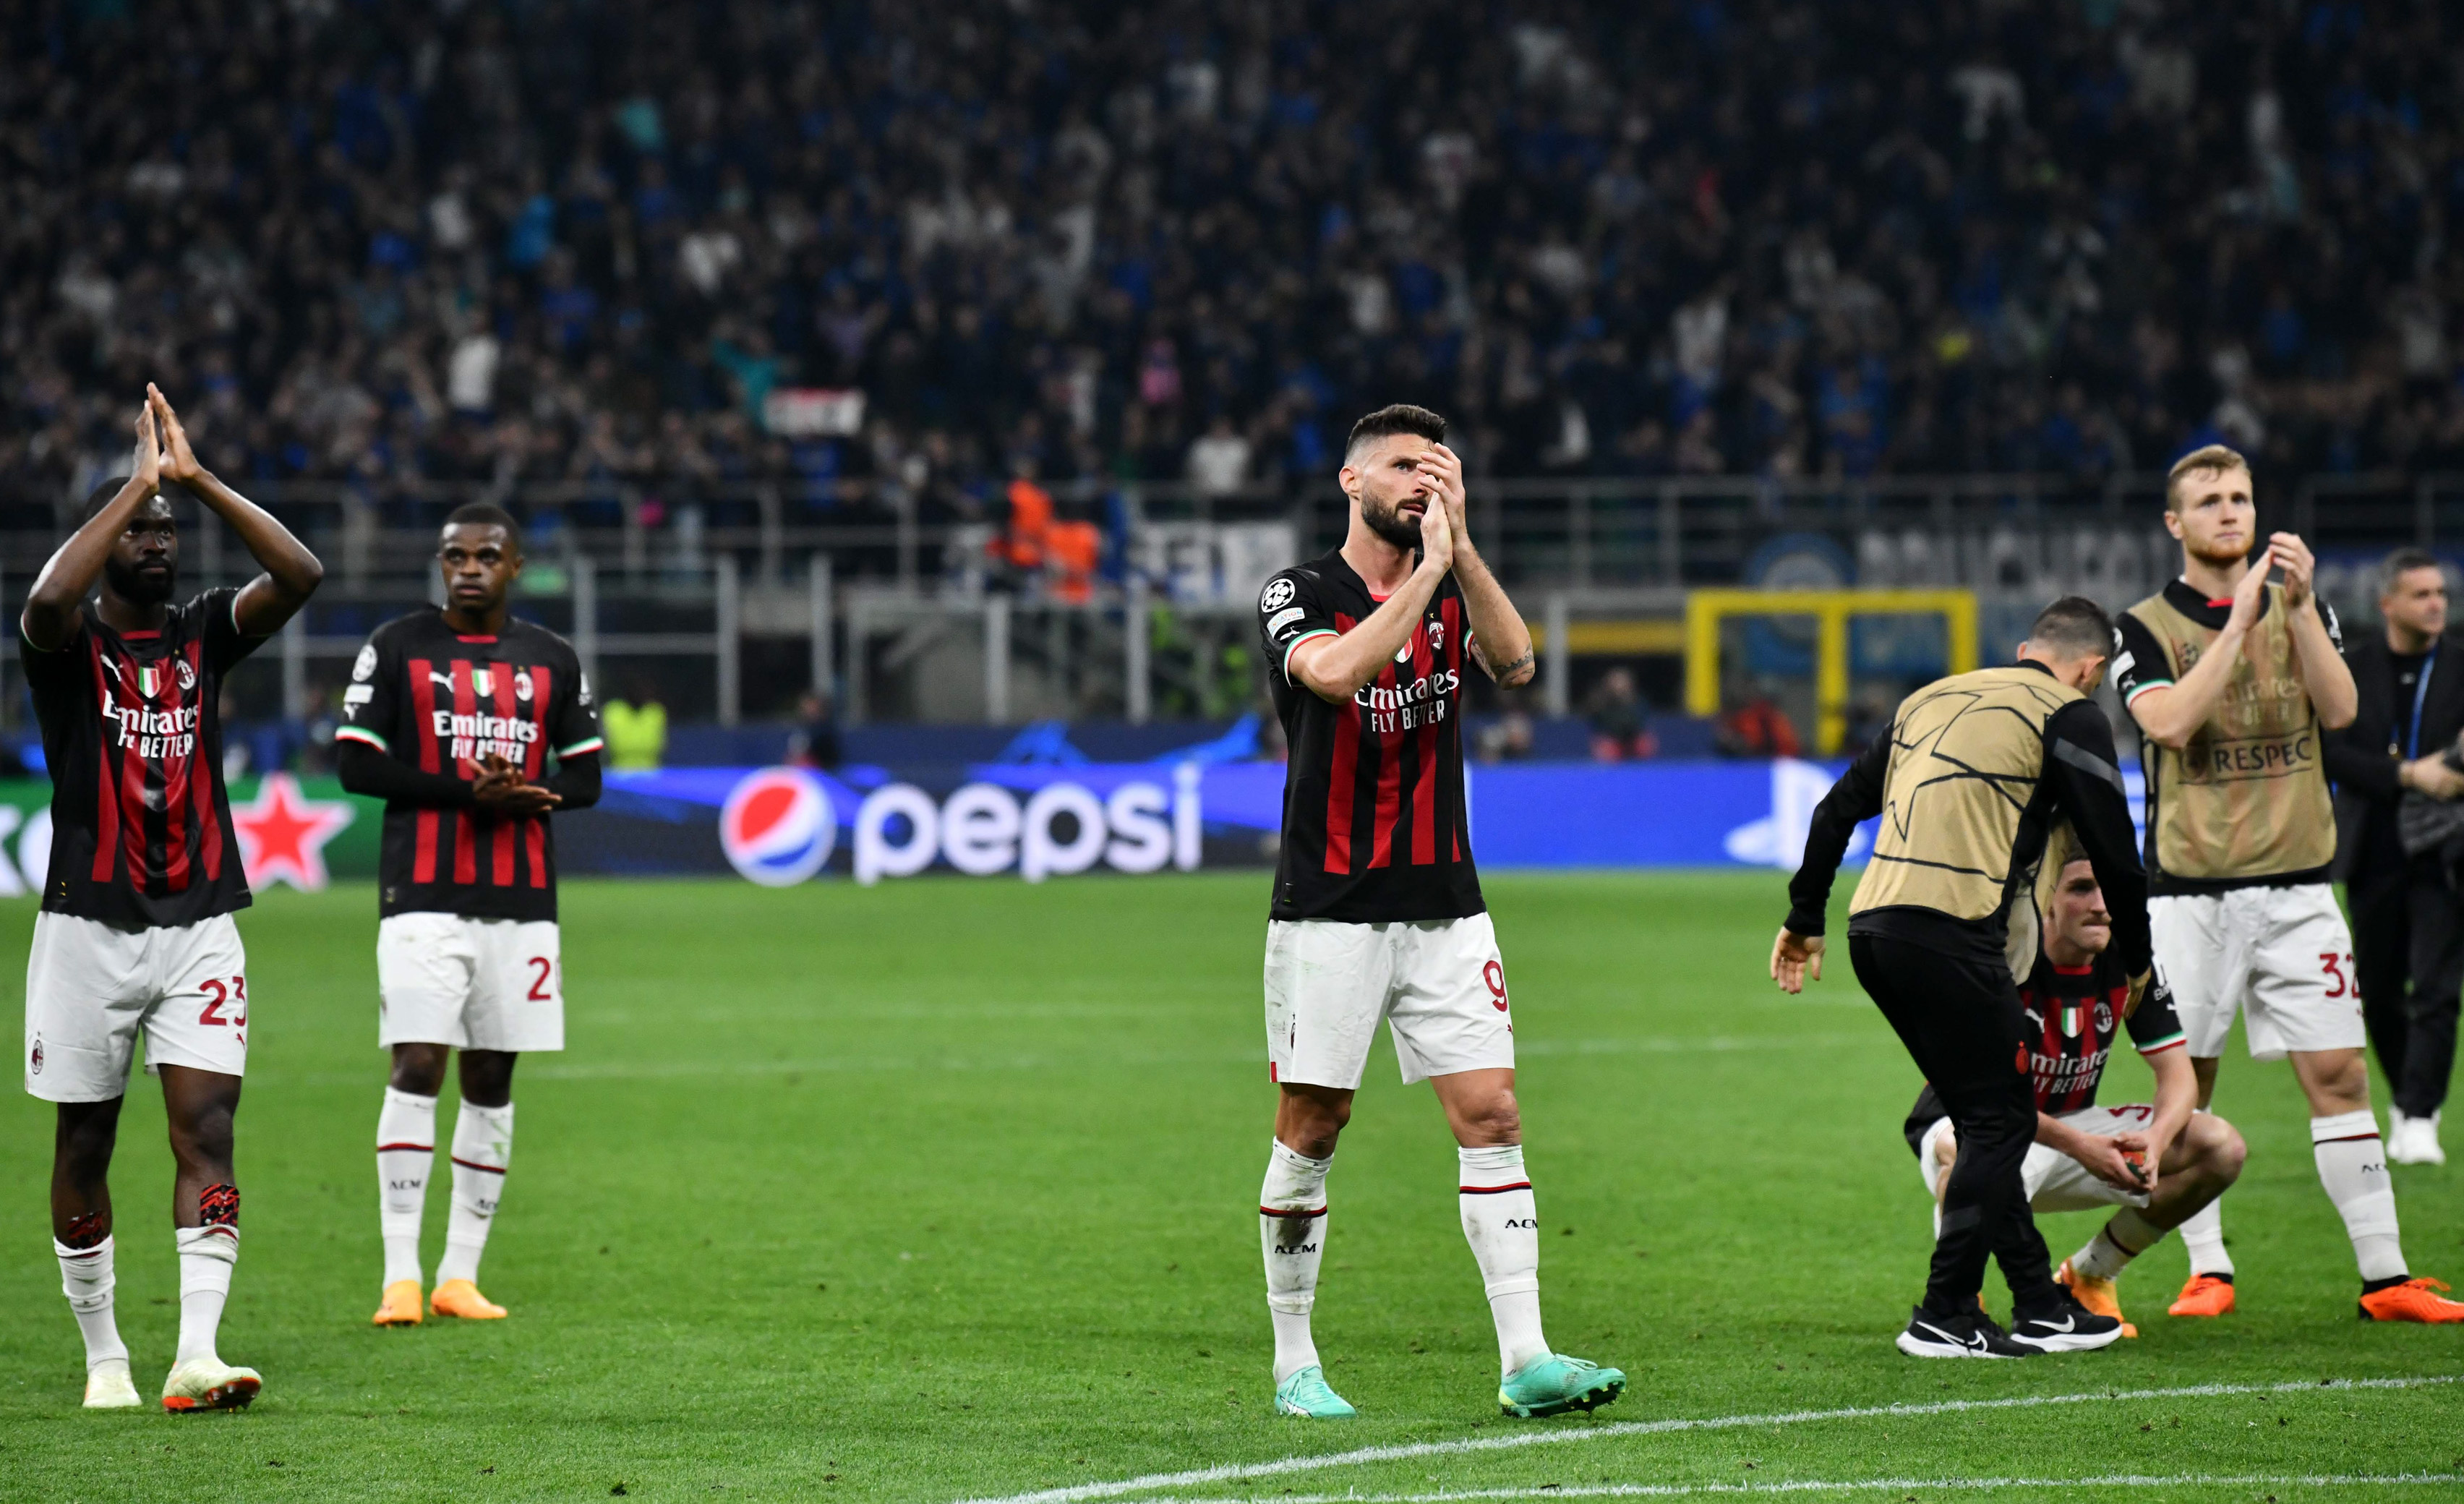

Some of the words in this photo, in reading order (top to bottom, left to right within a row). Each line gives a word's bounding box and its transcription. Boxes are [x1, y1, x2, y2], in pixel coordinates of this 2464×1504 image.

[1354, 668, 1459, 710] Emirates
[432, 709, 539, 743] Emirates
[1371, 711, 1395, 732] FLY
[1401, 699, 1445, 730] BETTER
[140, 732, 193, 759] BETTER
[450, 737, 474, 759] FLY
[853, 761, 1202, 886] pepsi
[527, 956, 559, 1002] 2
[1482, 960, 1508, 1012] 9
[2319, 952, 2361, 999] 32
[199, 976, 247, 1027] 23
[2031, 1047, 2110, 1075] mirate
[2050, 1069, 2100, 1094] BETTER
[389, 1179, 422, 1191] ACM
[1274, 1243, 1317, 1255] ACM
